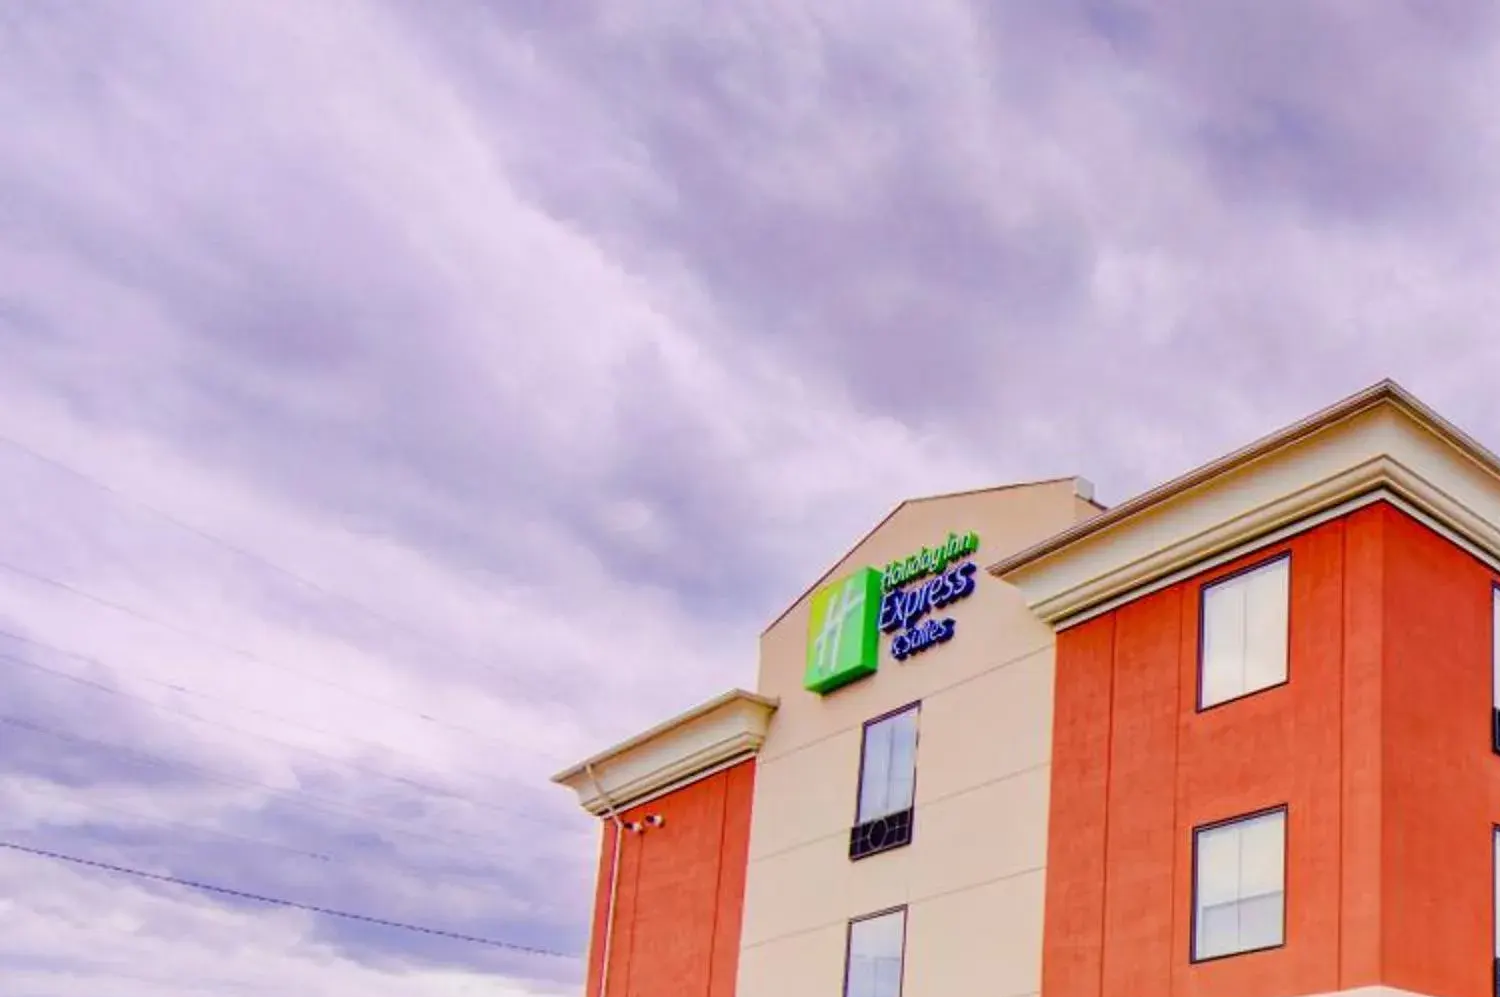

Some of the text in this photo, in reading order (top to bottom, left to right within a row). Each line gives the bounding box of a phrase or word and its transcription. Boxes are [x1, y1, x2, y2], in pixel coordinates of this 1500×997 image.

[881, 531, 978, 592] Holiday Inn
[879, 562, 976, 632] Express
[901, 617, 955, 653] Suites
